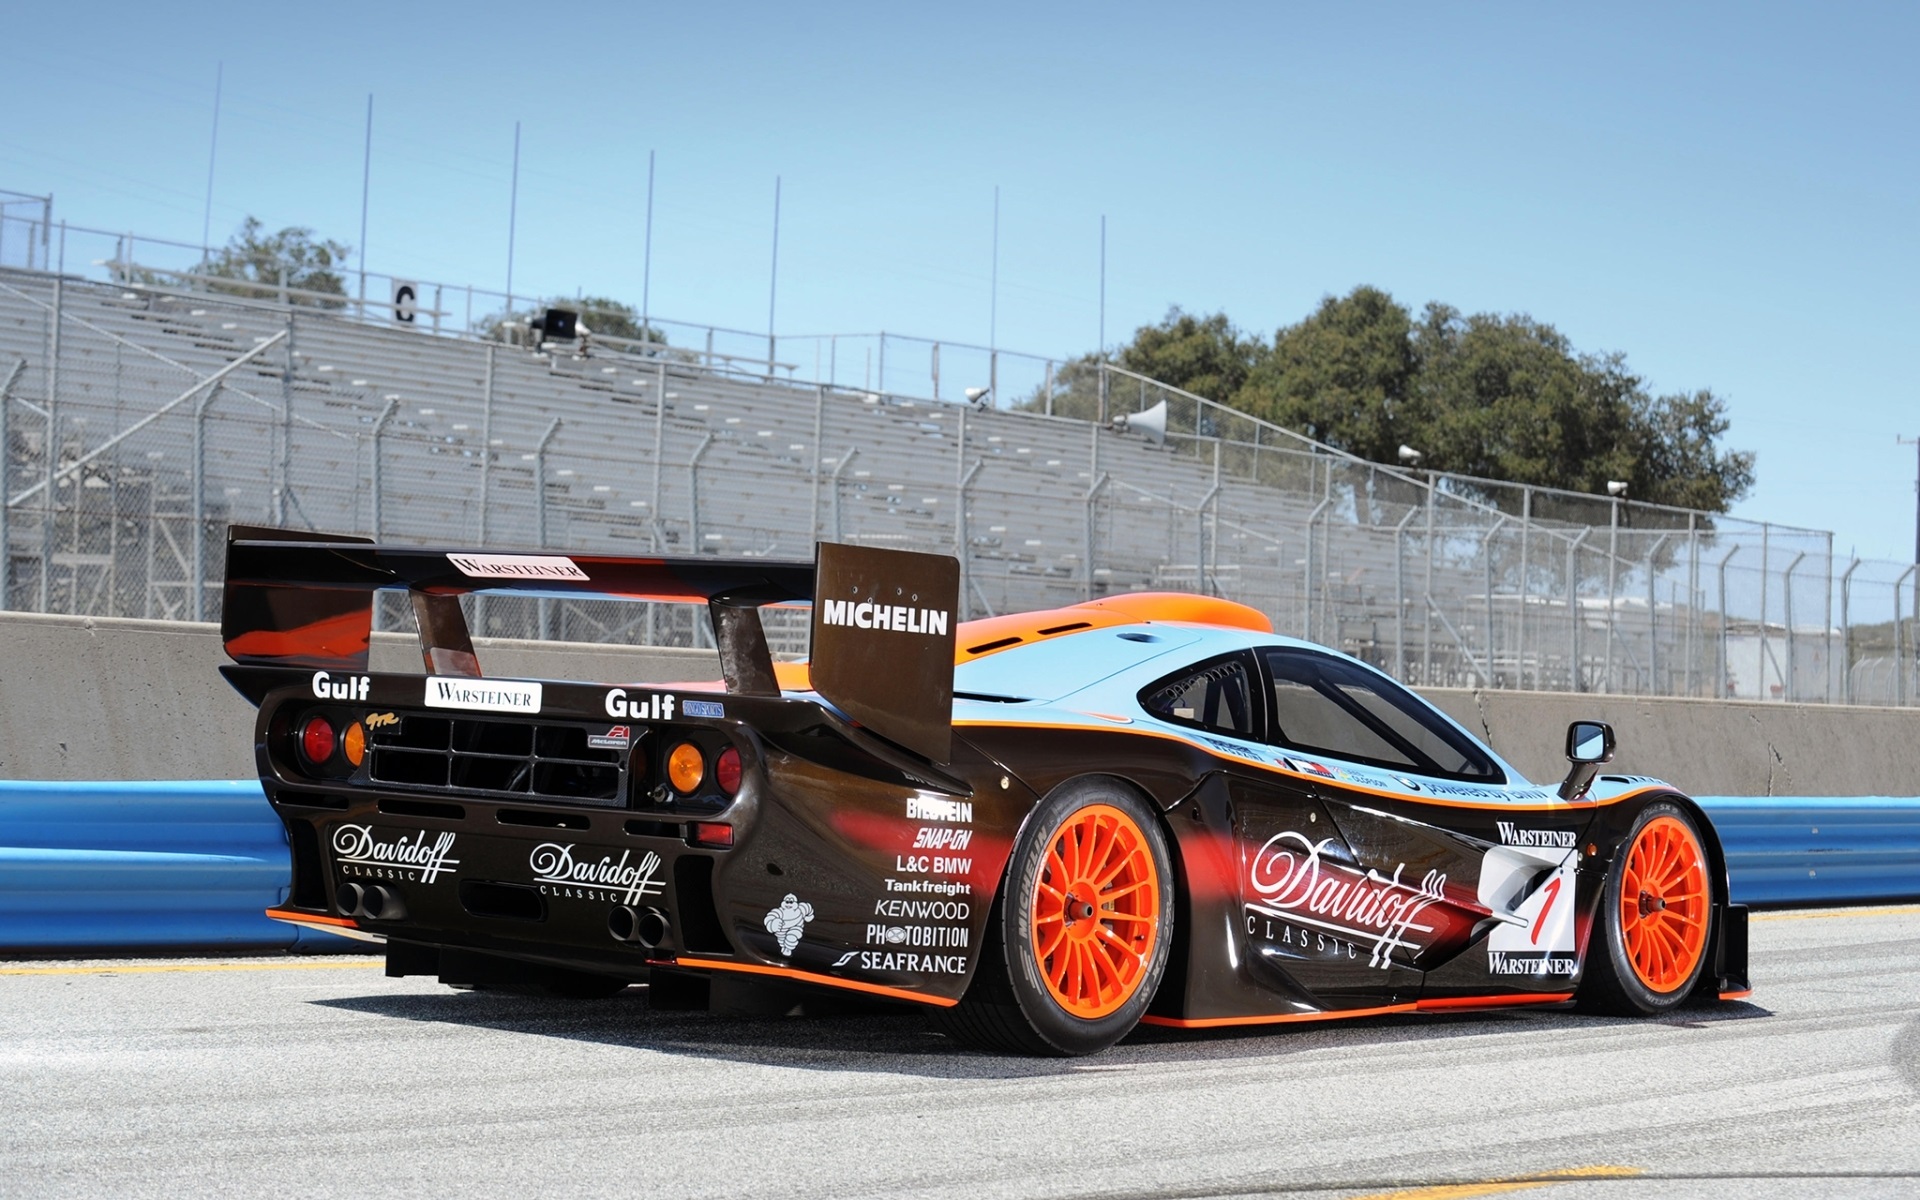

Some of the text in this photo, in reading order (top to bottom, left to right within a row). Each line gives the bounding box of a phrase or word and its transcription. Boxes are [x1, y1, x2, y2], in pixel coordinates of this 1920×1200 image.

[396, 285, 415, 322] C
[453, 558, 584, 577] WARSTEINER
[823, 599, 948, 636] MICHELIN
[312, 671, 370, 700] Gulf
[437, 682, 532, 707] WARSTEINER
[605, 688, 675, 720] Gulf
[591, 738, 627, 746] McLaren
[1422, 782, 1488, 798] powered
[1490, 788, 1511, 802] by
[1496, 821, 1577, 847] WARSTEINER
[333, 823, 460, 883] Davidoff
[896, 854, 973, 875] L&C BMW
[342, 864, 416, 882] CLASSIC
[529, 842, 666, 905] Davidoff
[1018, 825, 1048, 939] MICHELIN
[539, 884, 618, 903] CLASSIC
[1248, 830, 1448, 970] Davidoff
[874, 899, 970, 920] KENWOOD
[1531, 877, 1561, 945] 1
[1247, 915, 1357, 960] CLASSIC
[861, 951, 967, 974] SEAFRANCE
[1488, 952, 1576, 975] WARSTEINER
